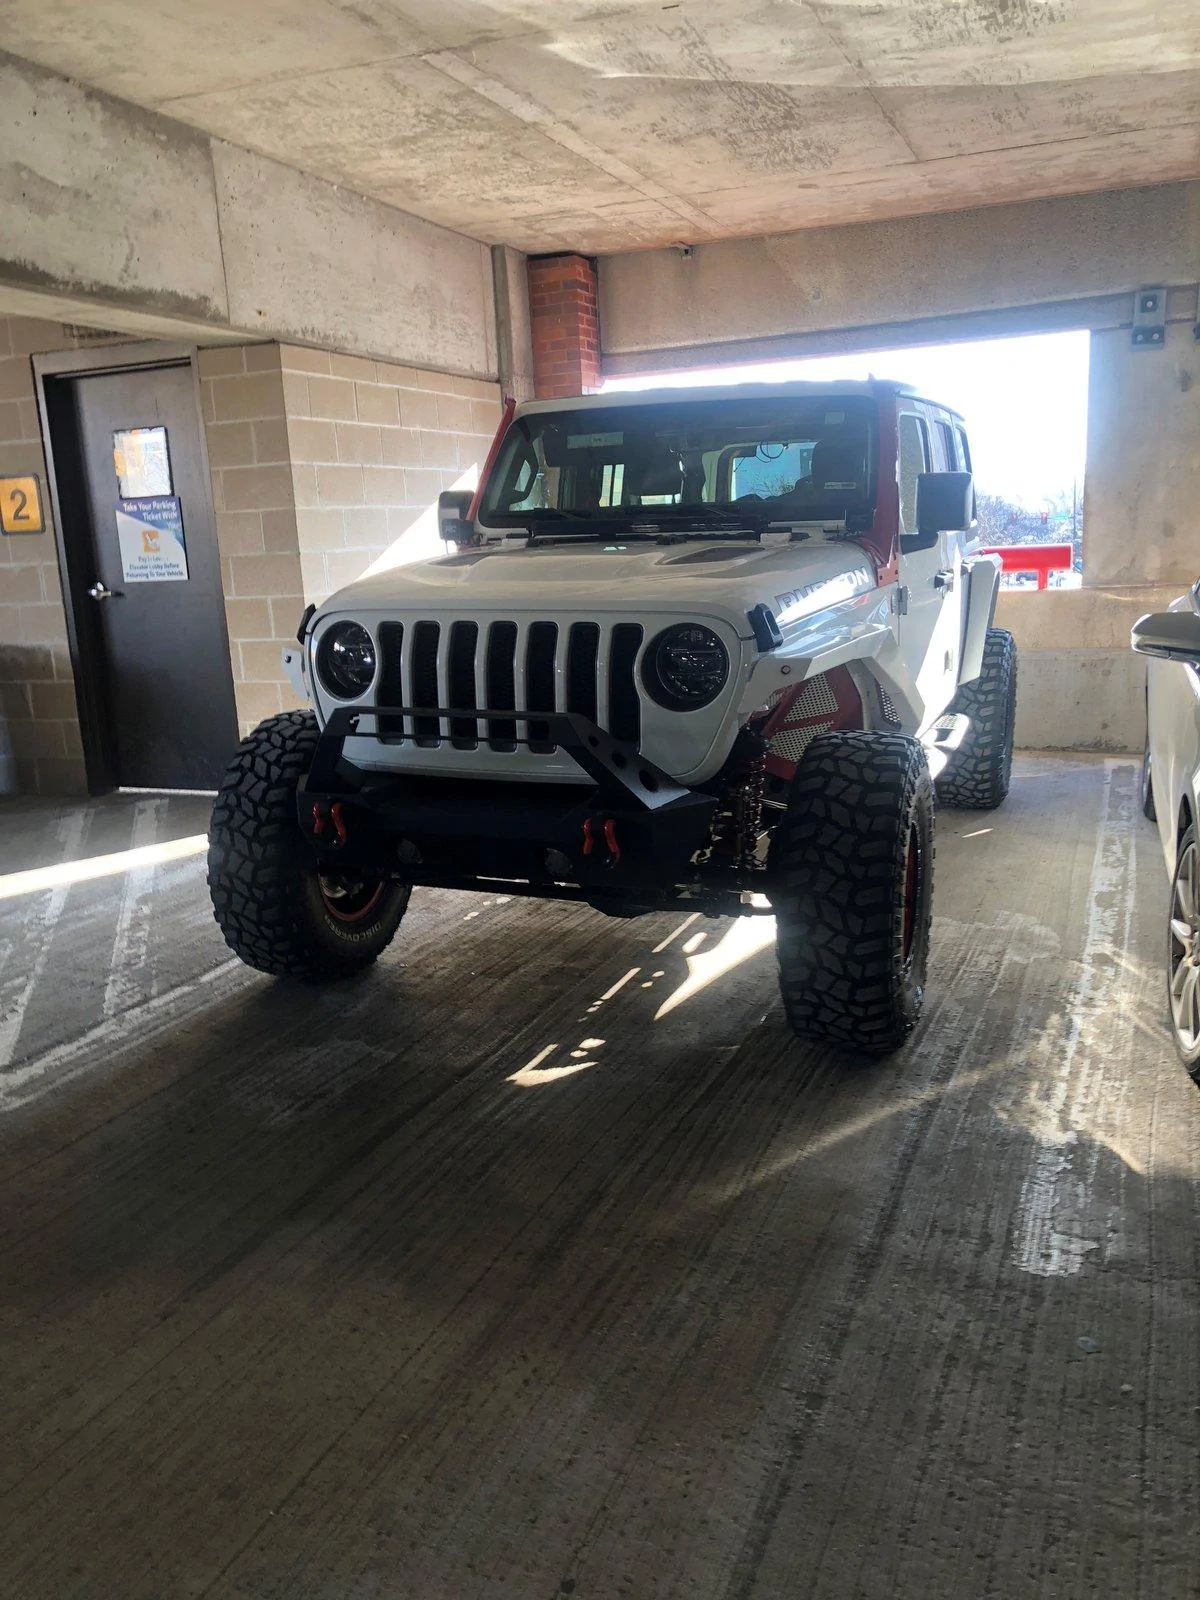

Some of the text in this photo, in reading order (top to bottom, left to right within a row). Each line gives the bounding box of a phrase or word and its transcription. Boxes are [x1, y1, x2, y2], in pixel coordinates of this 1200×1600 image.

[10, 488, 30, 521] 2
[123, 500, 176, 512] Take Your Parking
[142, 510, 178, 522] Ticket With
[774, 566, 869, 613] RUBON
